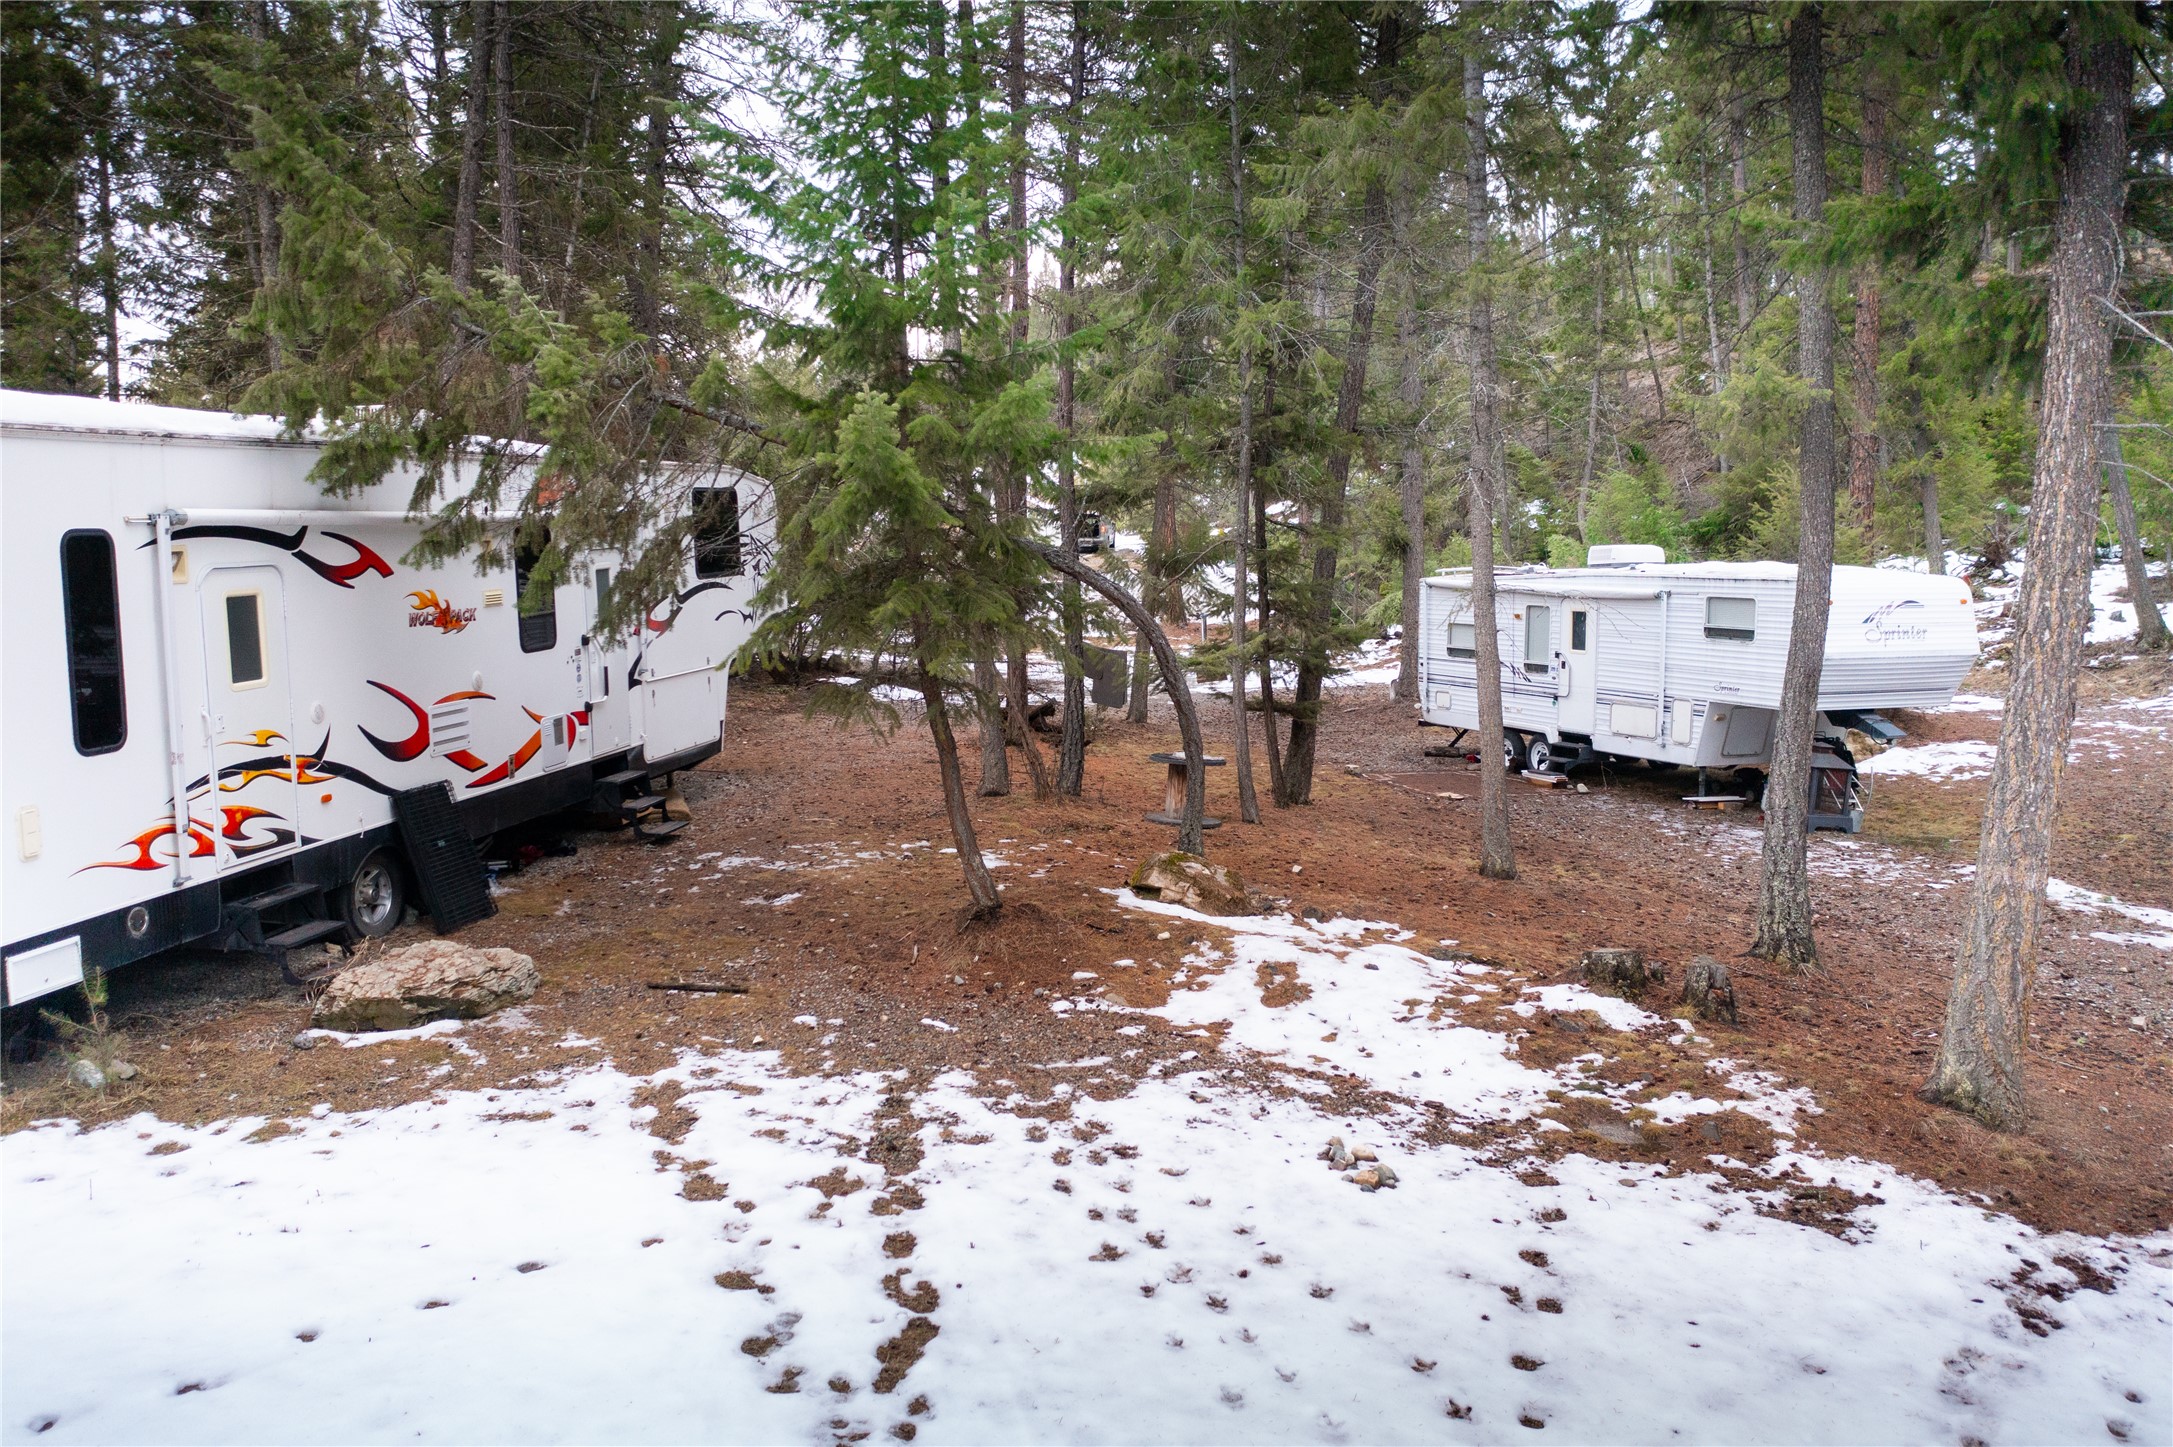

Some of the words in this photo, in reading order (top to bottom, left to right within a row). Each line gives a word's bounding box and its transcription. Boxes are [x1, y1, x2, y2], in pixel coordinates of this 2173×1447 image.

[408, 611, 440, 627] WOLF
[450, 607, 477, 624] PACK
[1865, 618, 1927, 648] Sprinter
